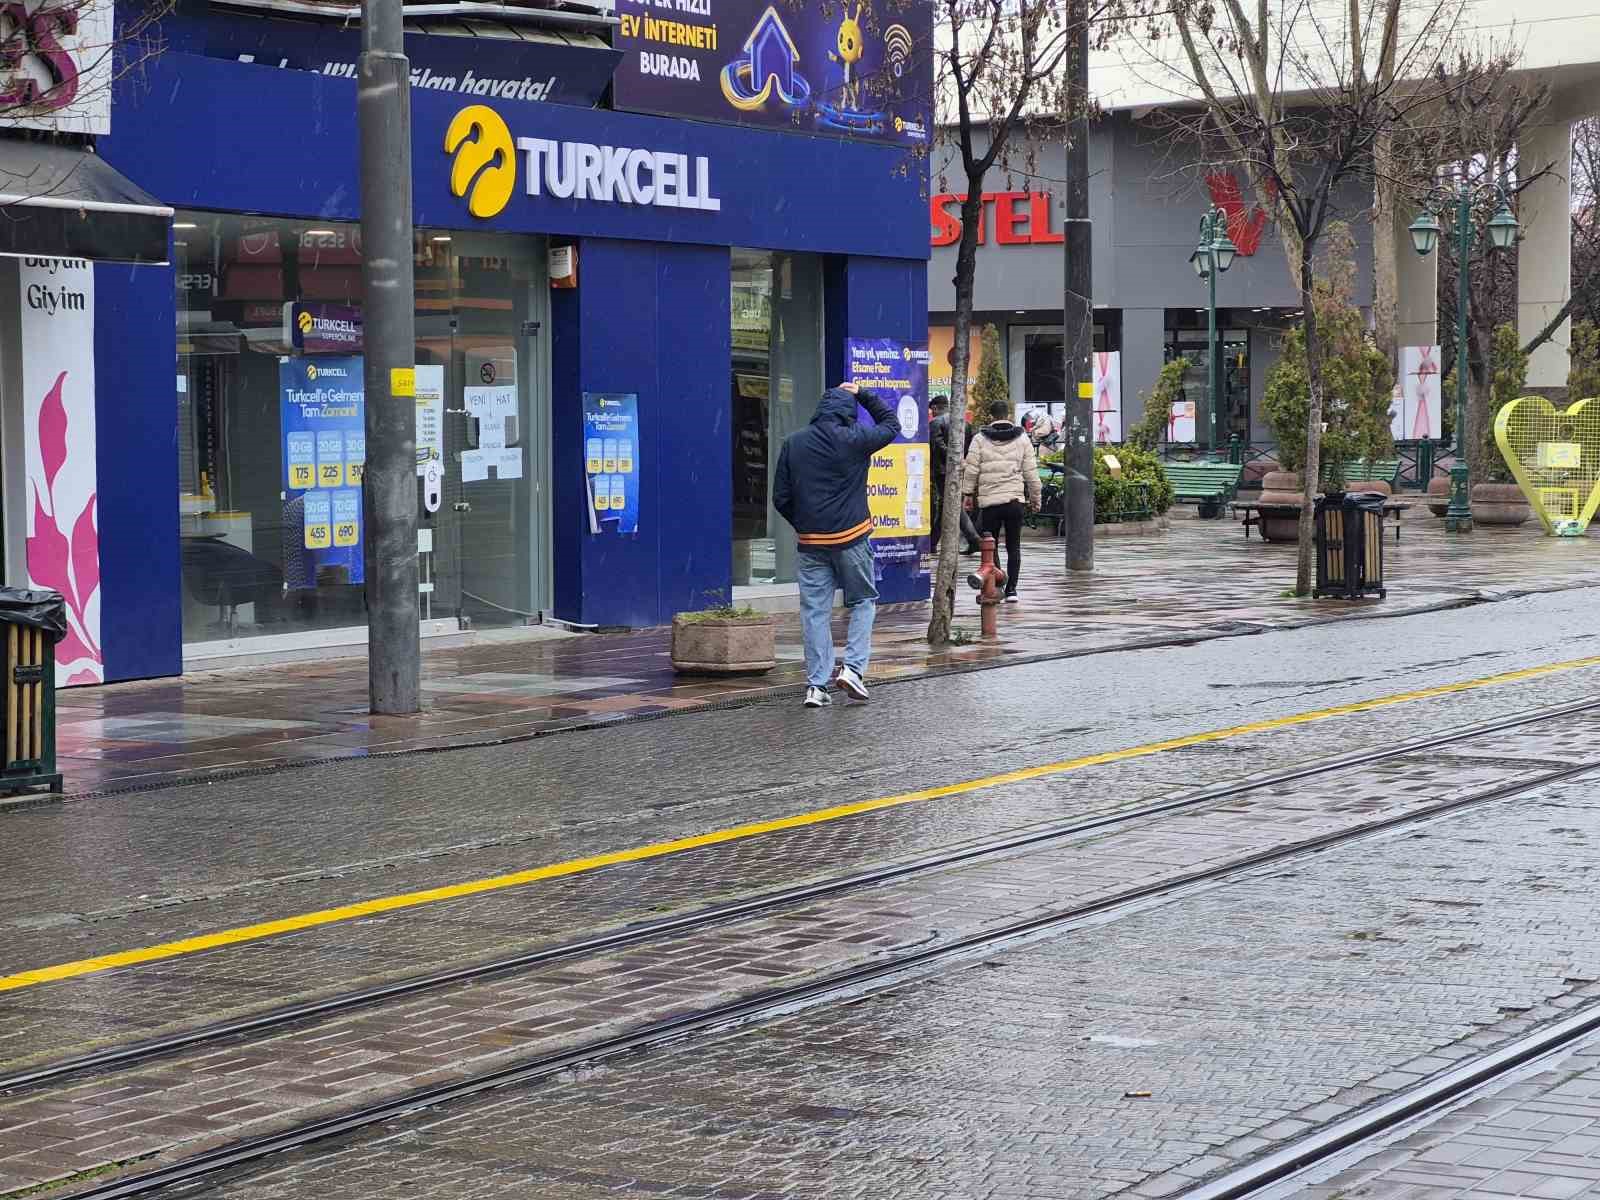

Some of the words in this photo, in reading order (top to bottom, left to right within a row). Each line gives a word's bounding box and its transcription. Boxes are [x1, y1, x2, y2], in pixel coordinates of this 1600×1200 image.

[620, 13, 641, 38] EV
[644, 11, 717, 50] İNTERNETİ
[640, 51, 701, 81] BURADA
[516, 136, 721, 212] TURKCELL
[27, 283, 85, 316] Giyim
[312, 317, 357, 333] TURKCELL
[316, 367, 348, 377] TURKCELL
[873, 456, 893, 471] Mbps
[295, 466, 309, 479] 175
[877, 484, 898, 499] Mbps
[879, 514, 900, 529] Mbps
[310, 527, 326, 538] 455
